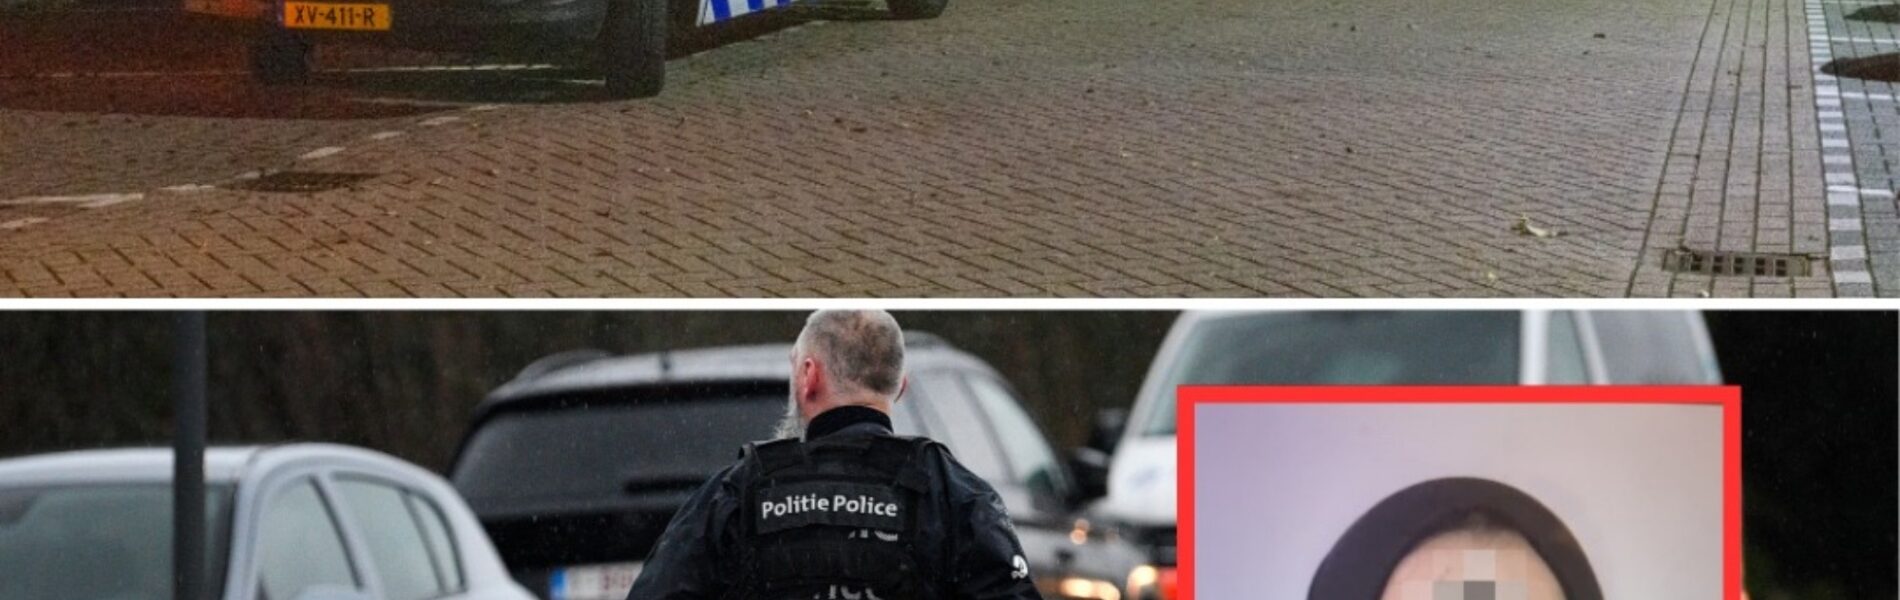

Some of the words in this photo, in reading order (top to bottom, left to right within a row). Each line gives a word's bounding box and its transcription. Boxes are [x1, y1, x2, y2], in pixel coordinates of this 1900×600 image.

[294, 5, 375, 27] XV-411-R
[761, 493, 830, 520] Politie
[833, 494, 898, 517] Police
